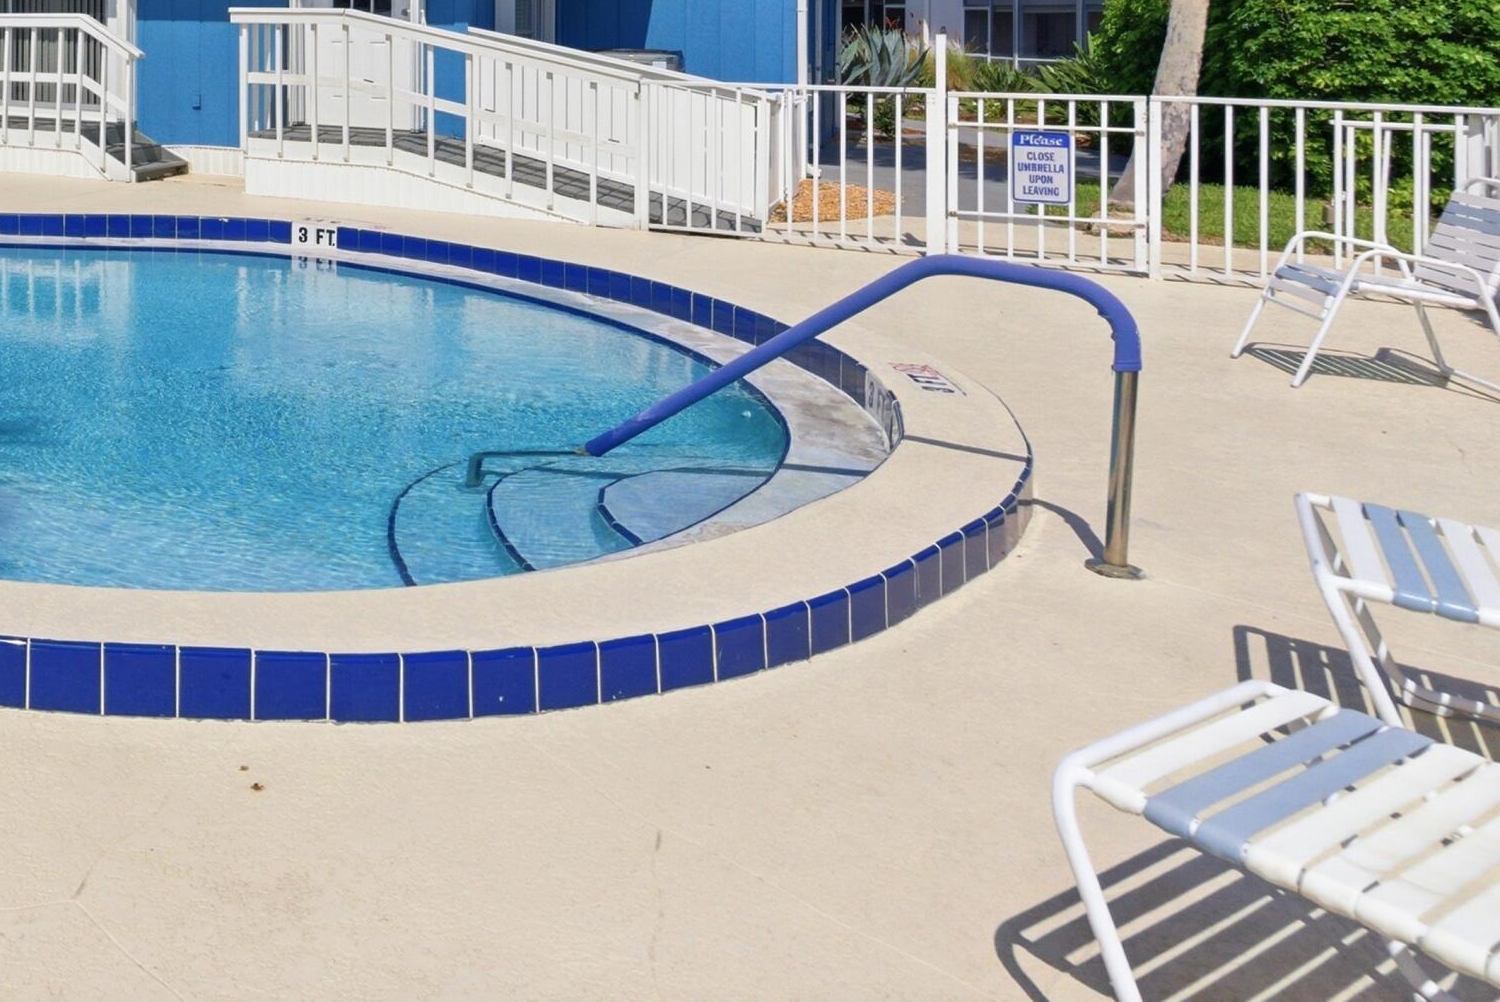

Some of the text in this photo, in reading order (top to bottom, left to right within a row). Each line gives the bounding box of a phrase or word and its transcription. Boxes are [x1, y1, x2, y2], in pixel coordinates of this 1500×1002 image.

[1019, 134, 1063, 146] Please
[1026, 151, 1055, 161] CLOSE
[1017, 162, 1064, 173] UMBRELLA
[1029, 175, 1053, 184] UPON
[1022, 185, 1060, 196] LEAVING
[298, 226, 308, 243] 3
